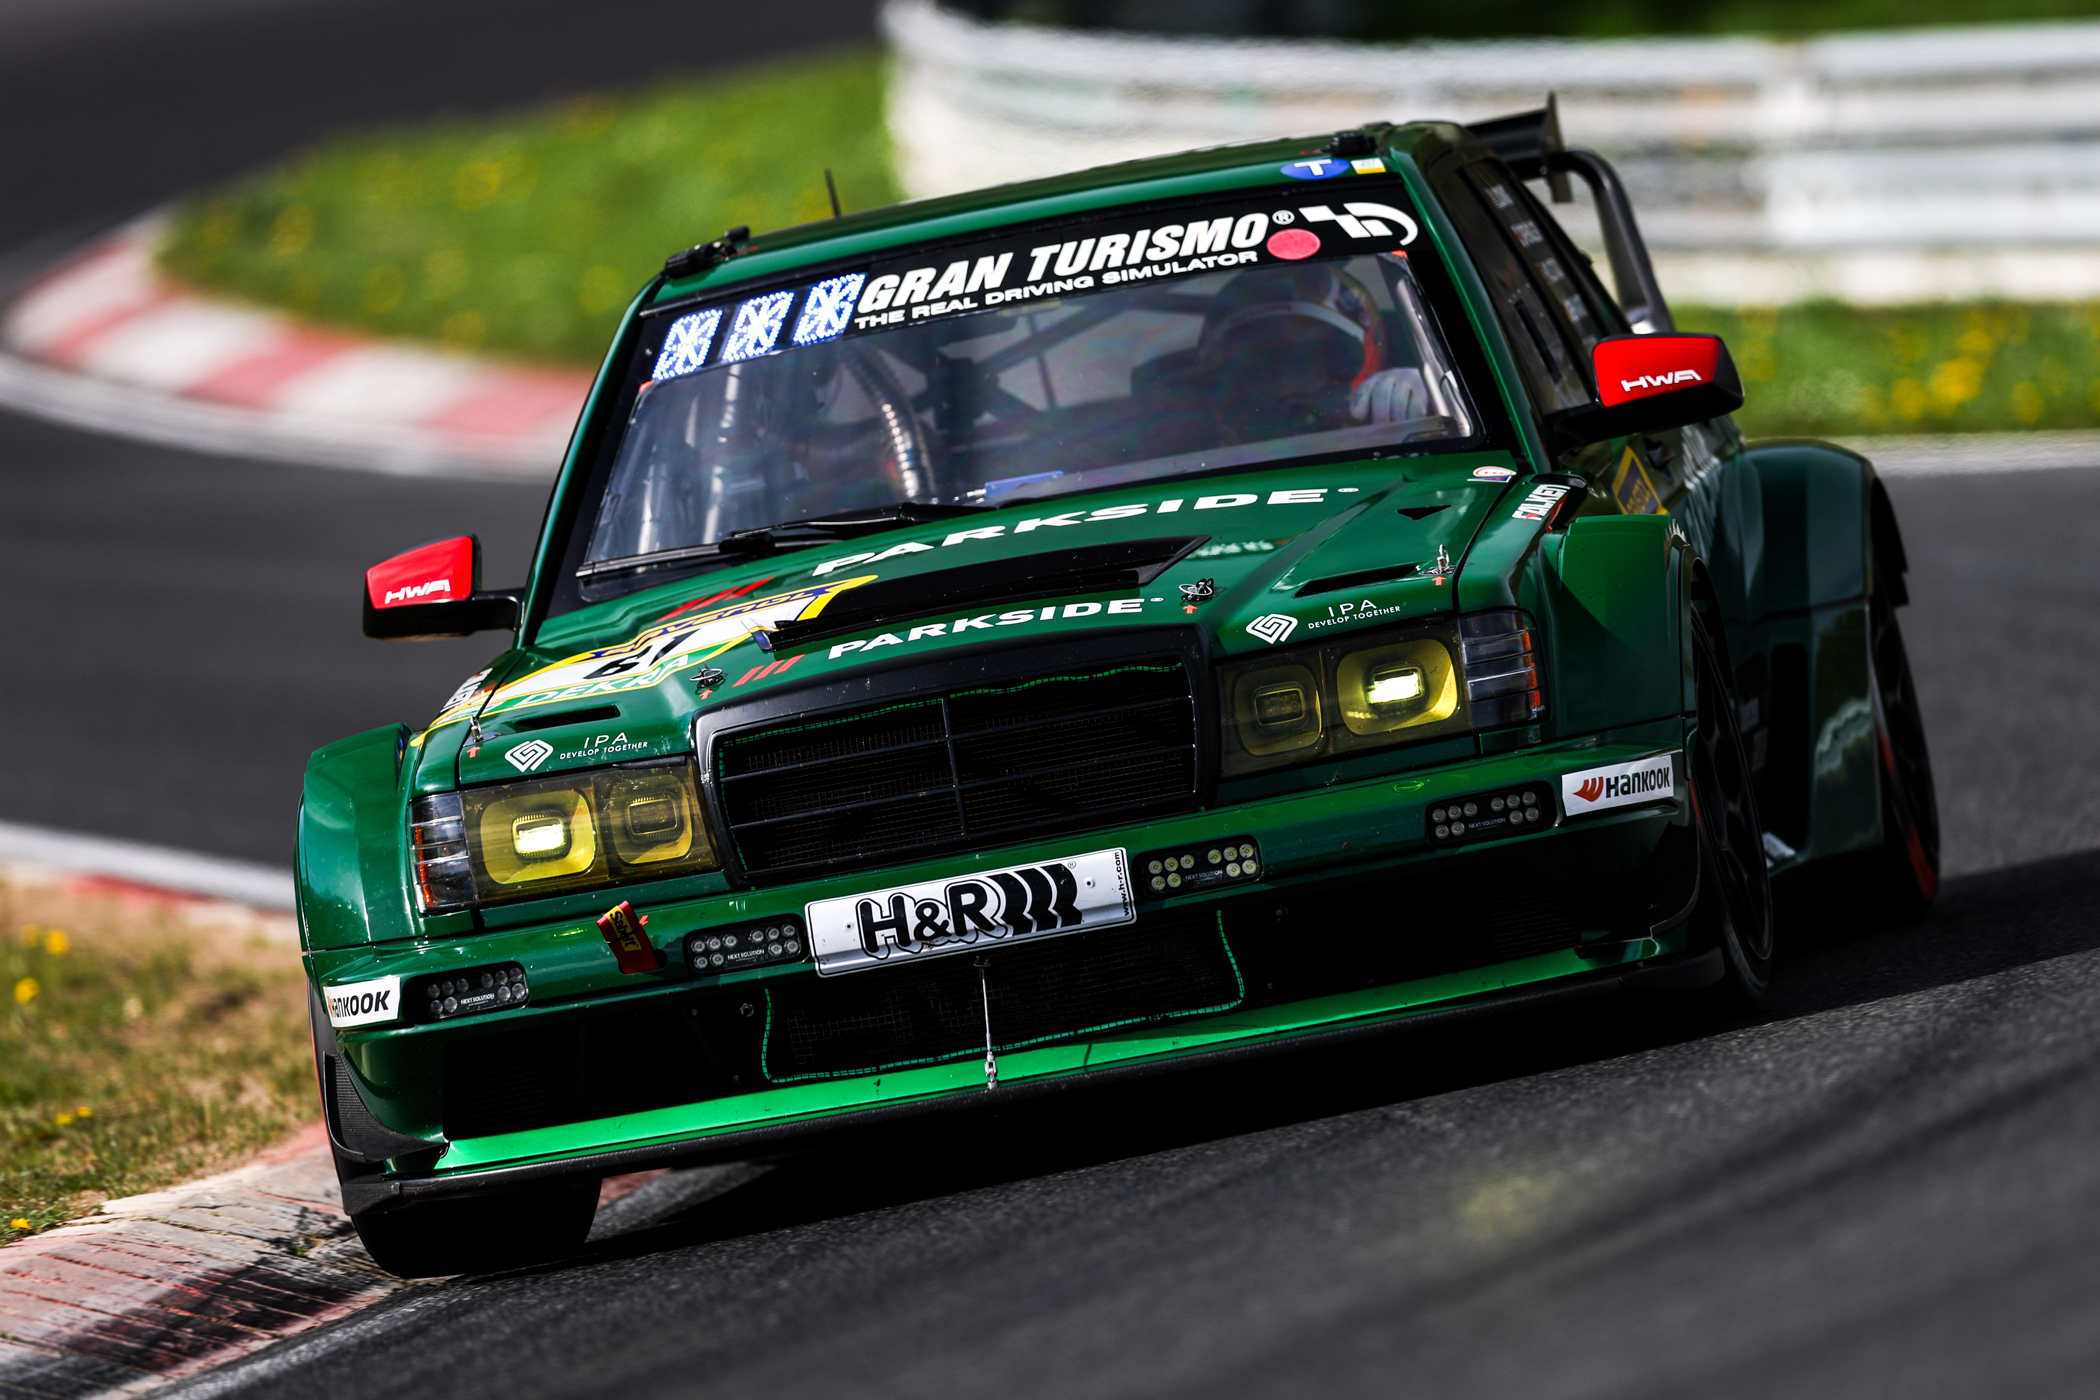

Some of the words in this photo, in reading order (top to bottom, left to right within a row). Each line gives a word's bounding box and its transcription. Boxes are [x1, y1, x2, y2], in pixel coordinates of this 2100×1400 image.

[854, 309, 905, 330] THE
[911, 297, 979, 319] REAL
[985, 275, 1095, 305] DRIVING
[1101, 250, 1258, 285] SIMULATOR
[857, 253, 1014, 314] GRAN
[1621, 369, 1702, 392] HWA
[812, 488, 1329, 576] PARKSIDE
[384, 579, 451, 604] HWA
[1308, 615, 1350, 630] DEVELOP
[1353, 606, 1401, 620] TOGETHER
[1328, 599, 1377, 618] IPA
[828, 597, 1145, 660] PARKSIDE
[513, 654, 690, 707] DEKRA
[559, 748, 600, 760] DEVELOP
[603, 741, 648, 754] TOGETHER
[584, 732, 628, 749] IPA
[1114, 851, 1131, 917] www.h-r.com
[857, 881, 1003, 957] H&R
